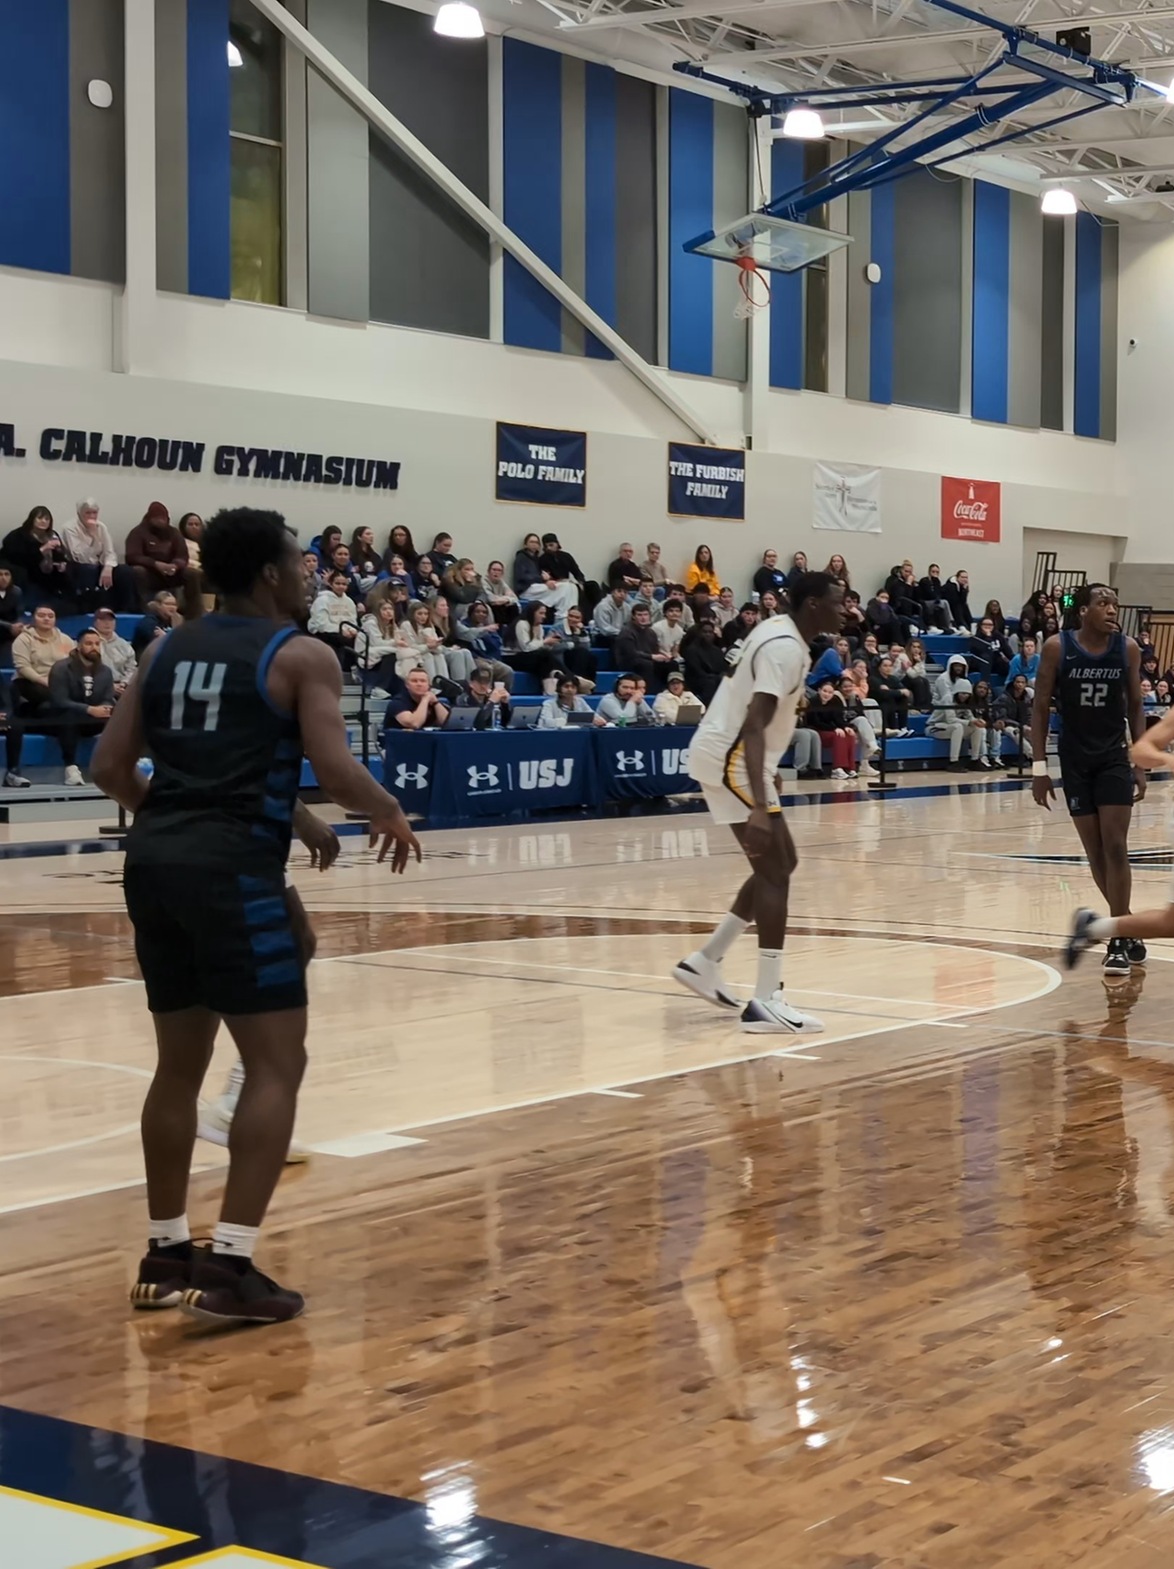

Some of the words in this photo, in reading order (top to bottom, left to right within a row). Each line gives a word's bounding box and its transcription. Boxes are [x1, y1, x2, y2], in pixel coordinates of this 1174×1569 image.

[39, 427, 205, 473] CALHOUN
[213, 445, 401, 490] GYMNASIUM
[528, 444, 557, 461] THE
[498, 461, 535, 479] POLO
[537, 465, 586, 484] FAMILY
[669, 461, 694, 477] THE
[695, 464, 745, 483] FURBISH
[685, 482, 728, 499] FAMILY
[1068, 667, 1123, 680] ALBERTUS
[170, 661, 228, 732] 14
[1080, 683, 1109, 707] 22
[519, 758, 574, 790] USJ
[661, 749, 690, 776] US
